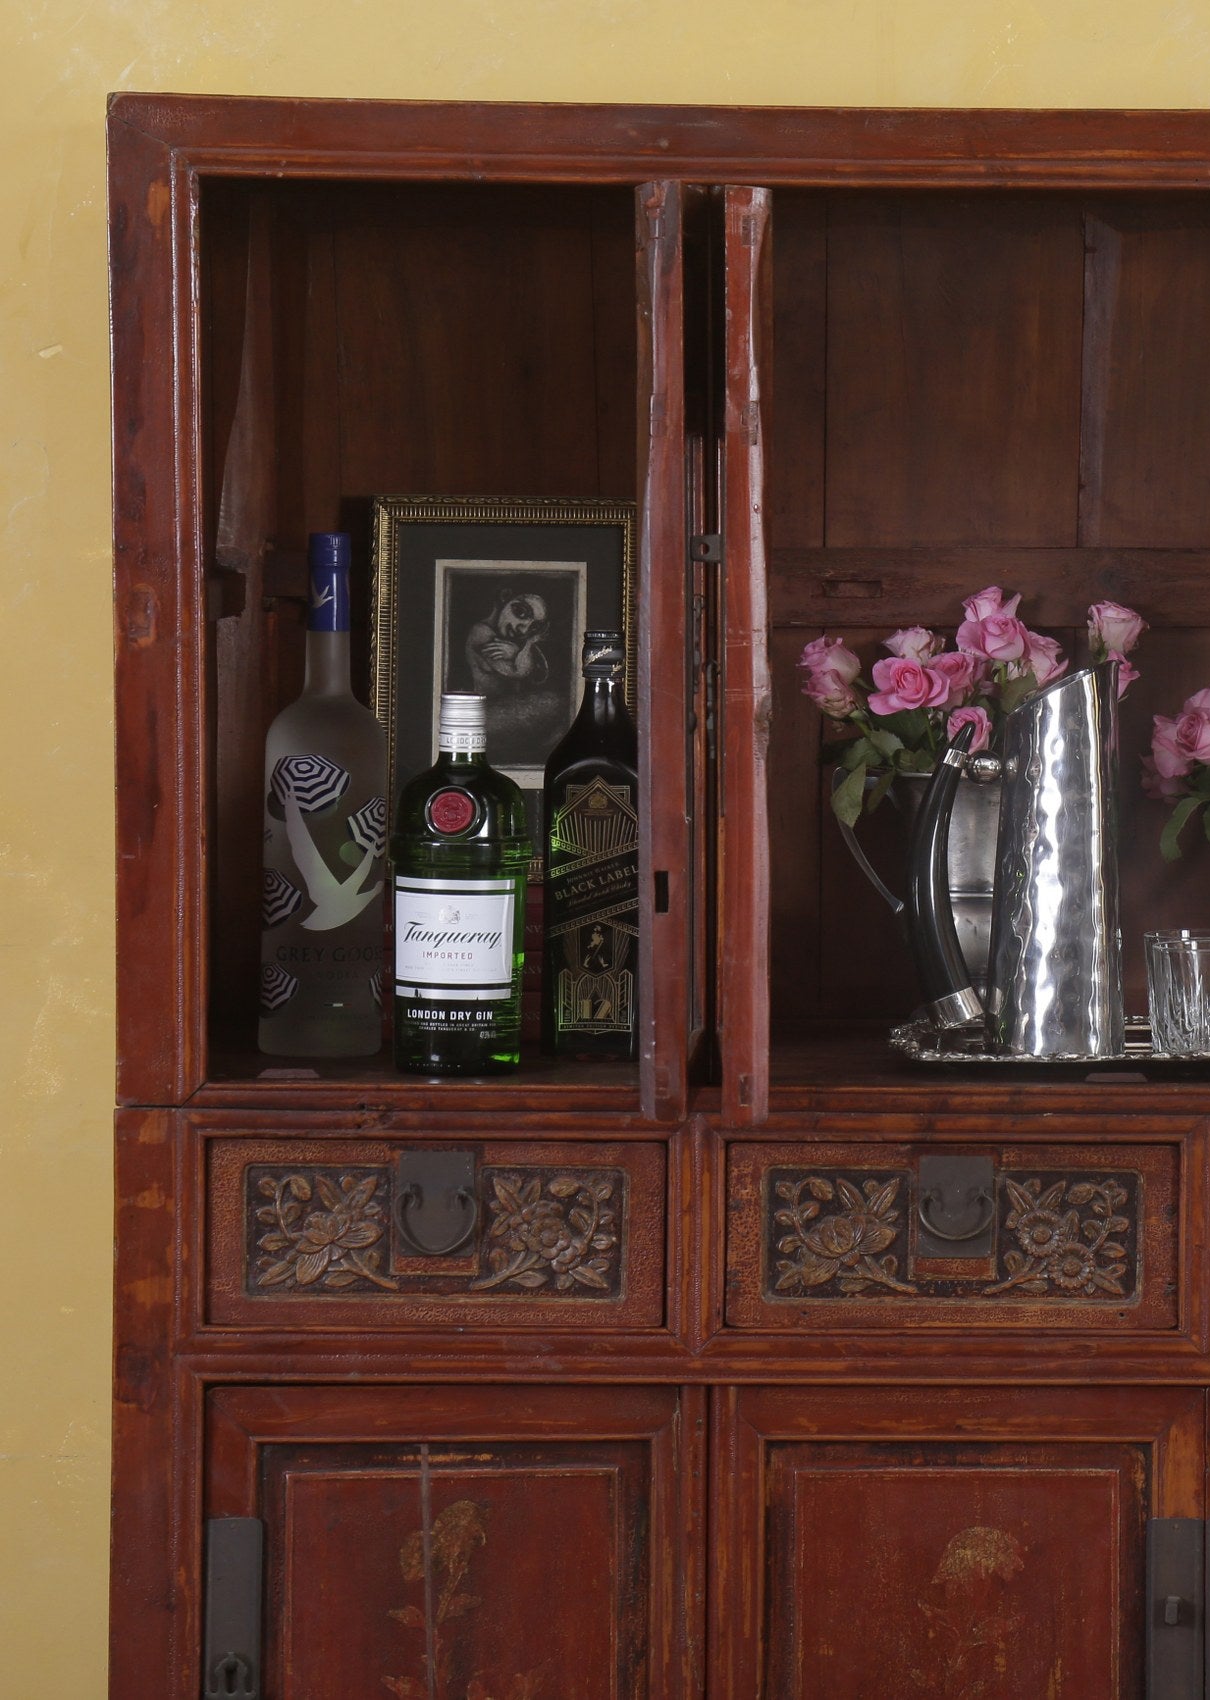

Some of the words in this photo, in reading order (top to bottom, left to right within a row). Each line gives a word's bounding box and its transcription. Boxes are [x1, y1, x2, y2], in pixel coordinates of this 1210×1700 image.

[554, 880, 596, 901] BLACK
[598, 864, 639, 885] LABEL
[404, 921, 503, 950] Tanqueray
[422, 951, 474, 961] IMPORTED
[407, 1008, 446, 1020] LONDON
[449, 1011, 472, 1020] DRY
[475, 1011, 494, 1020] GIN
